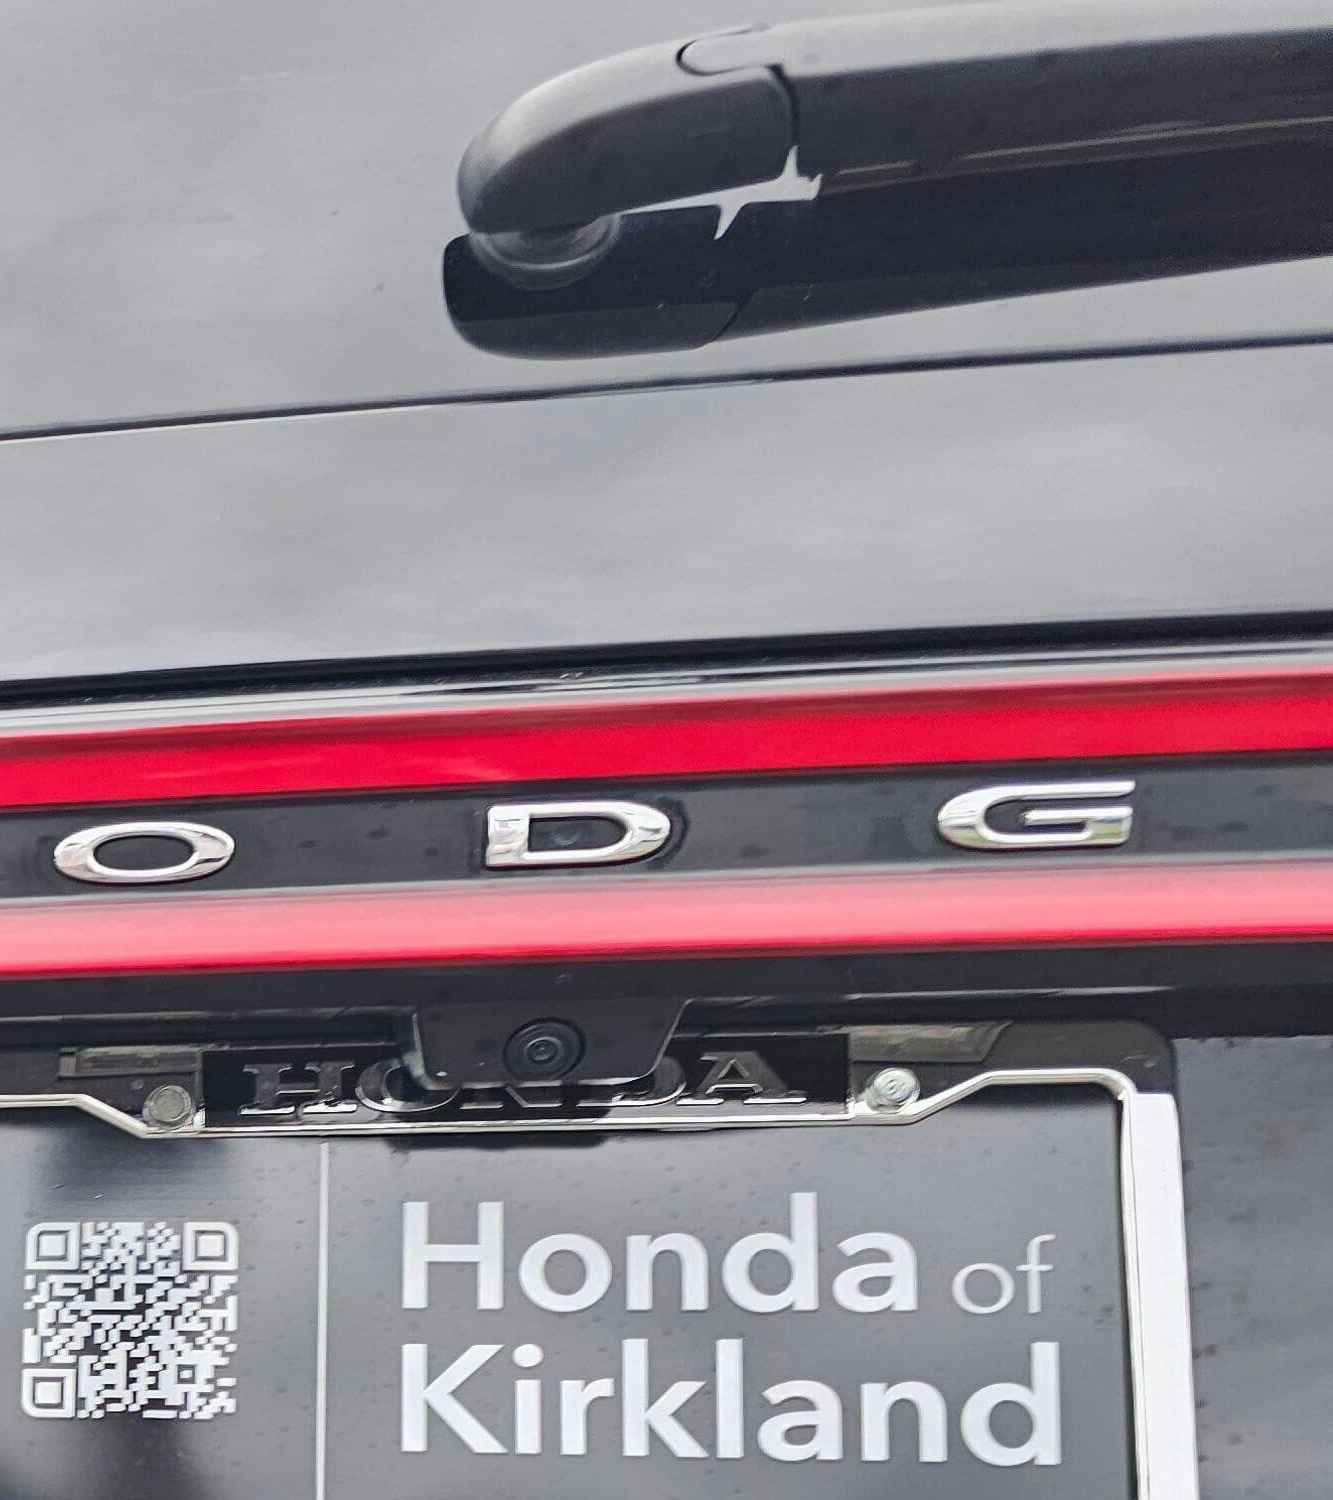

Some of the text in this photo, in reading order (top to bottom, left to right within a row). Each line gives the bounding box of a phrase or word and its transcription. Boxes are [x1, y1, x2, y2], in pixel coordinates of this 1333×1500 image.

[401, 1192, 1053, 1315] Honda of
[399, 1341, 1064, 1468] Kirkland
